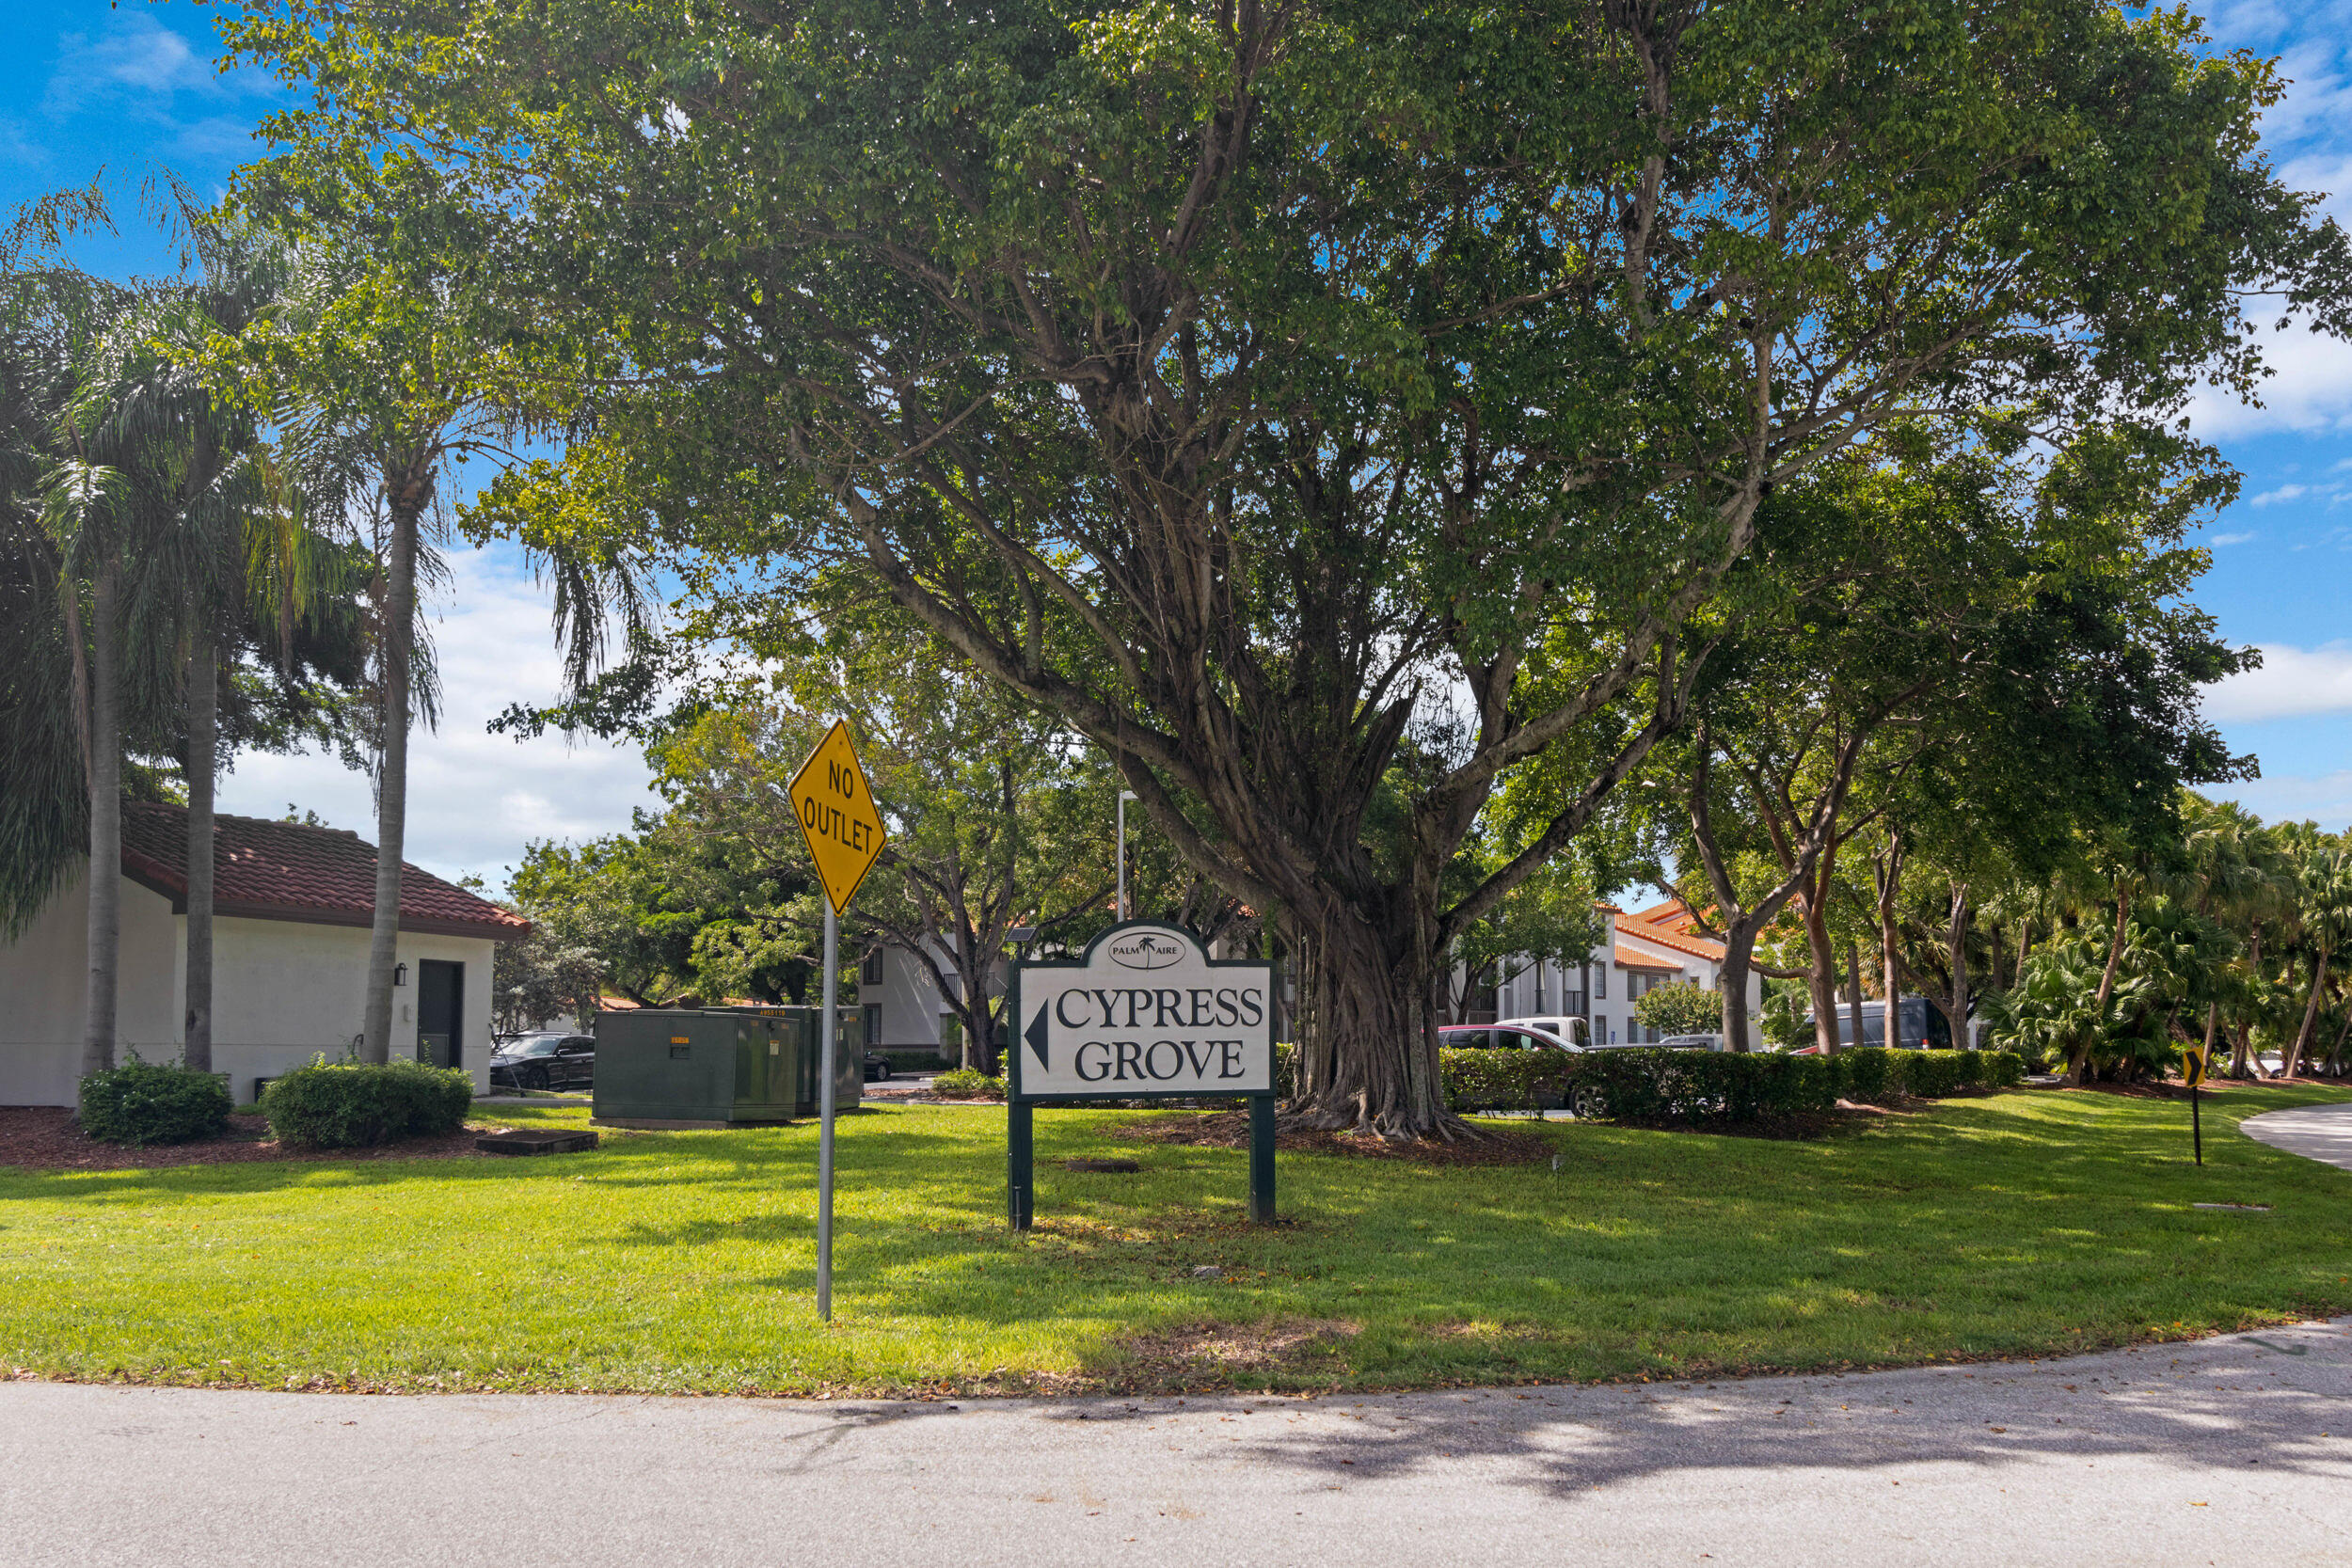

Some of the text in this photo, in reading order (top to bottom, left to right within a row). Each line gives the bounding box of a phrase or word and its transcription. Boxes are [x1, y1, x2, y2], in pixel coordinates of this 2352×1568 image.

[829, 759, 853, 799] NO
[803, 797, 872, 855] OUTLET
[1113, 946, 1177, 955] PALM AIRE
[1056, 989, 1263, 1028] CYPRESS
[1074, 1040, 1246, 1081] GROVE
